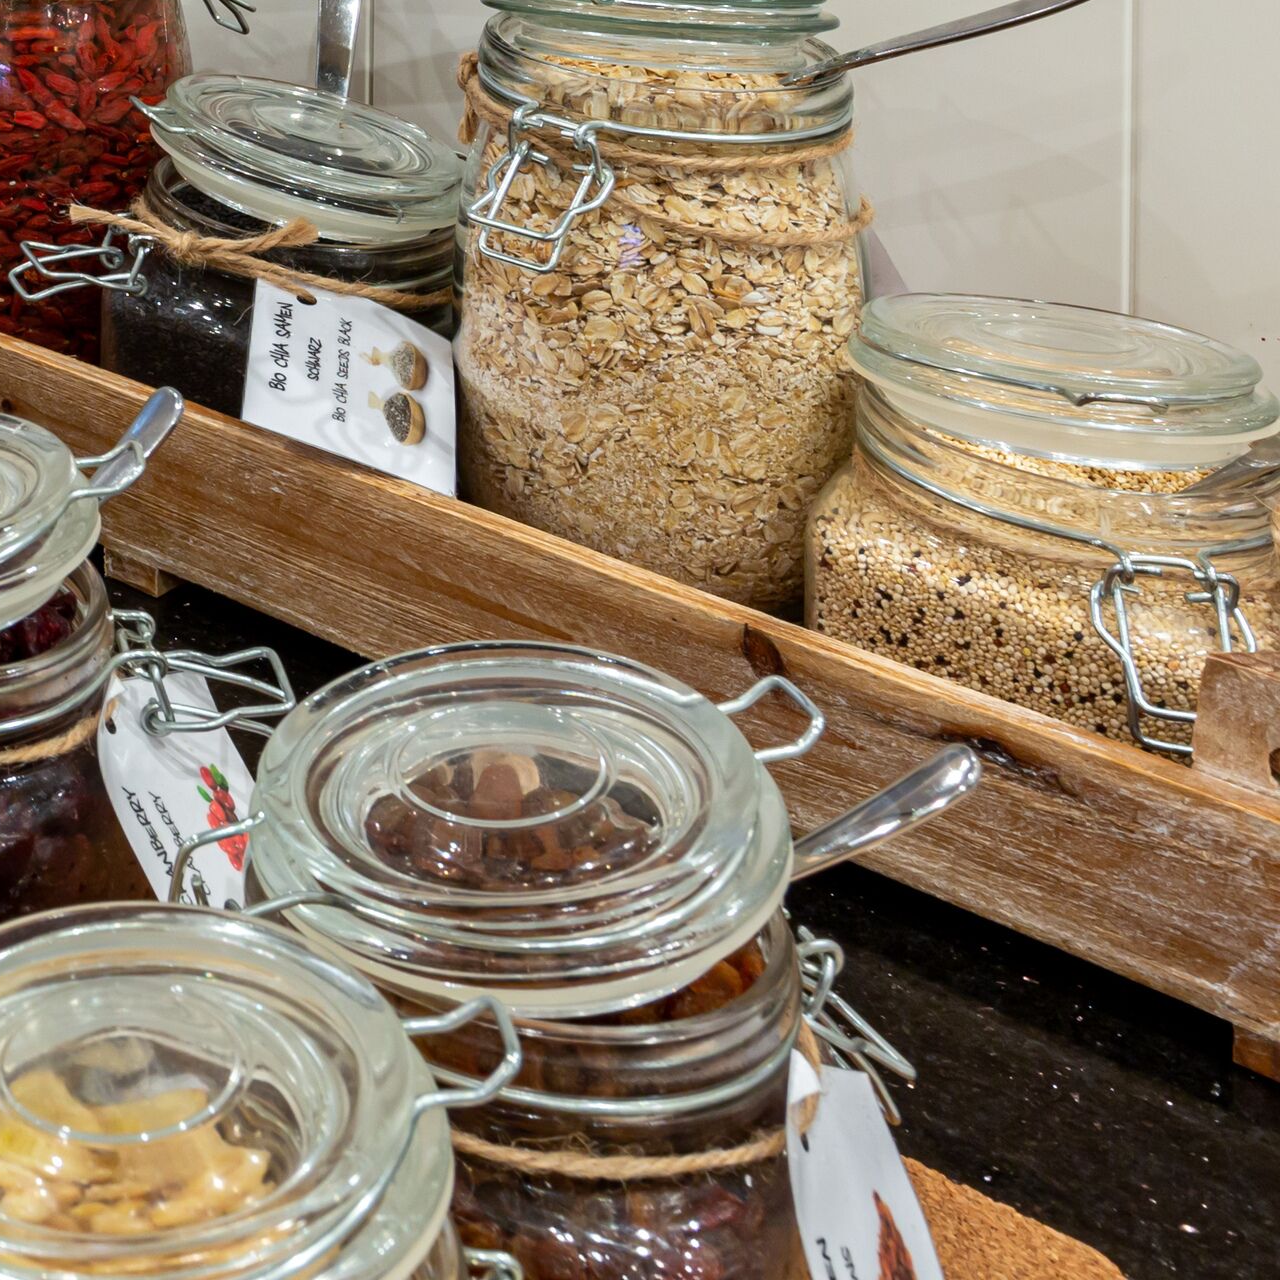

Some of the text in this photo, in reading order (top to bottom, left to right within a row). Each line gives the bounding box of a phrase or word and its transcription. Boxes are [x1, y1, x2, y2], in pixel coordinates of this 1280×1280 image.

[268, 300, 294, 392] BIO CHIA SAMEN
[304, 336, 323, 382] SCHWARZ
[331, 317, 353, 423] BIO CHIA SEEDS BLACK
[121, 785, 194, 906] CANBERRY
